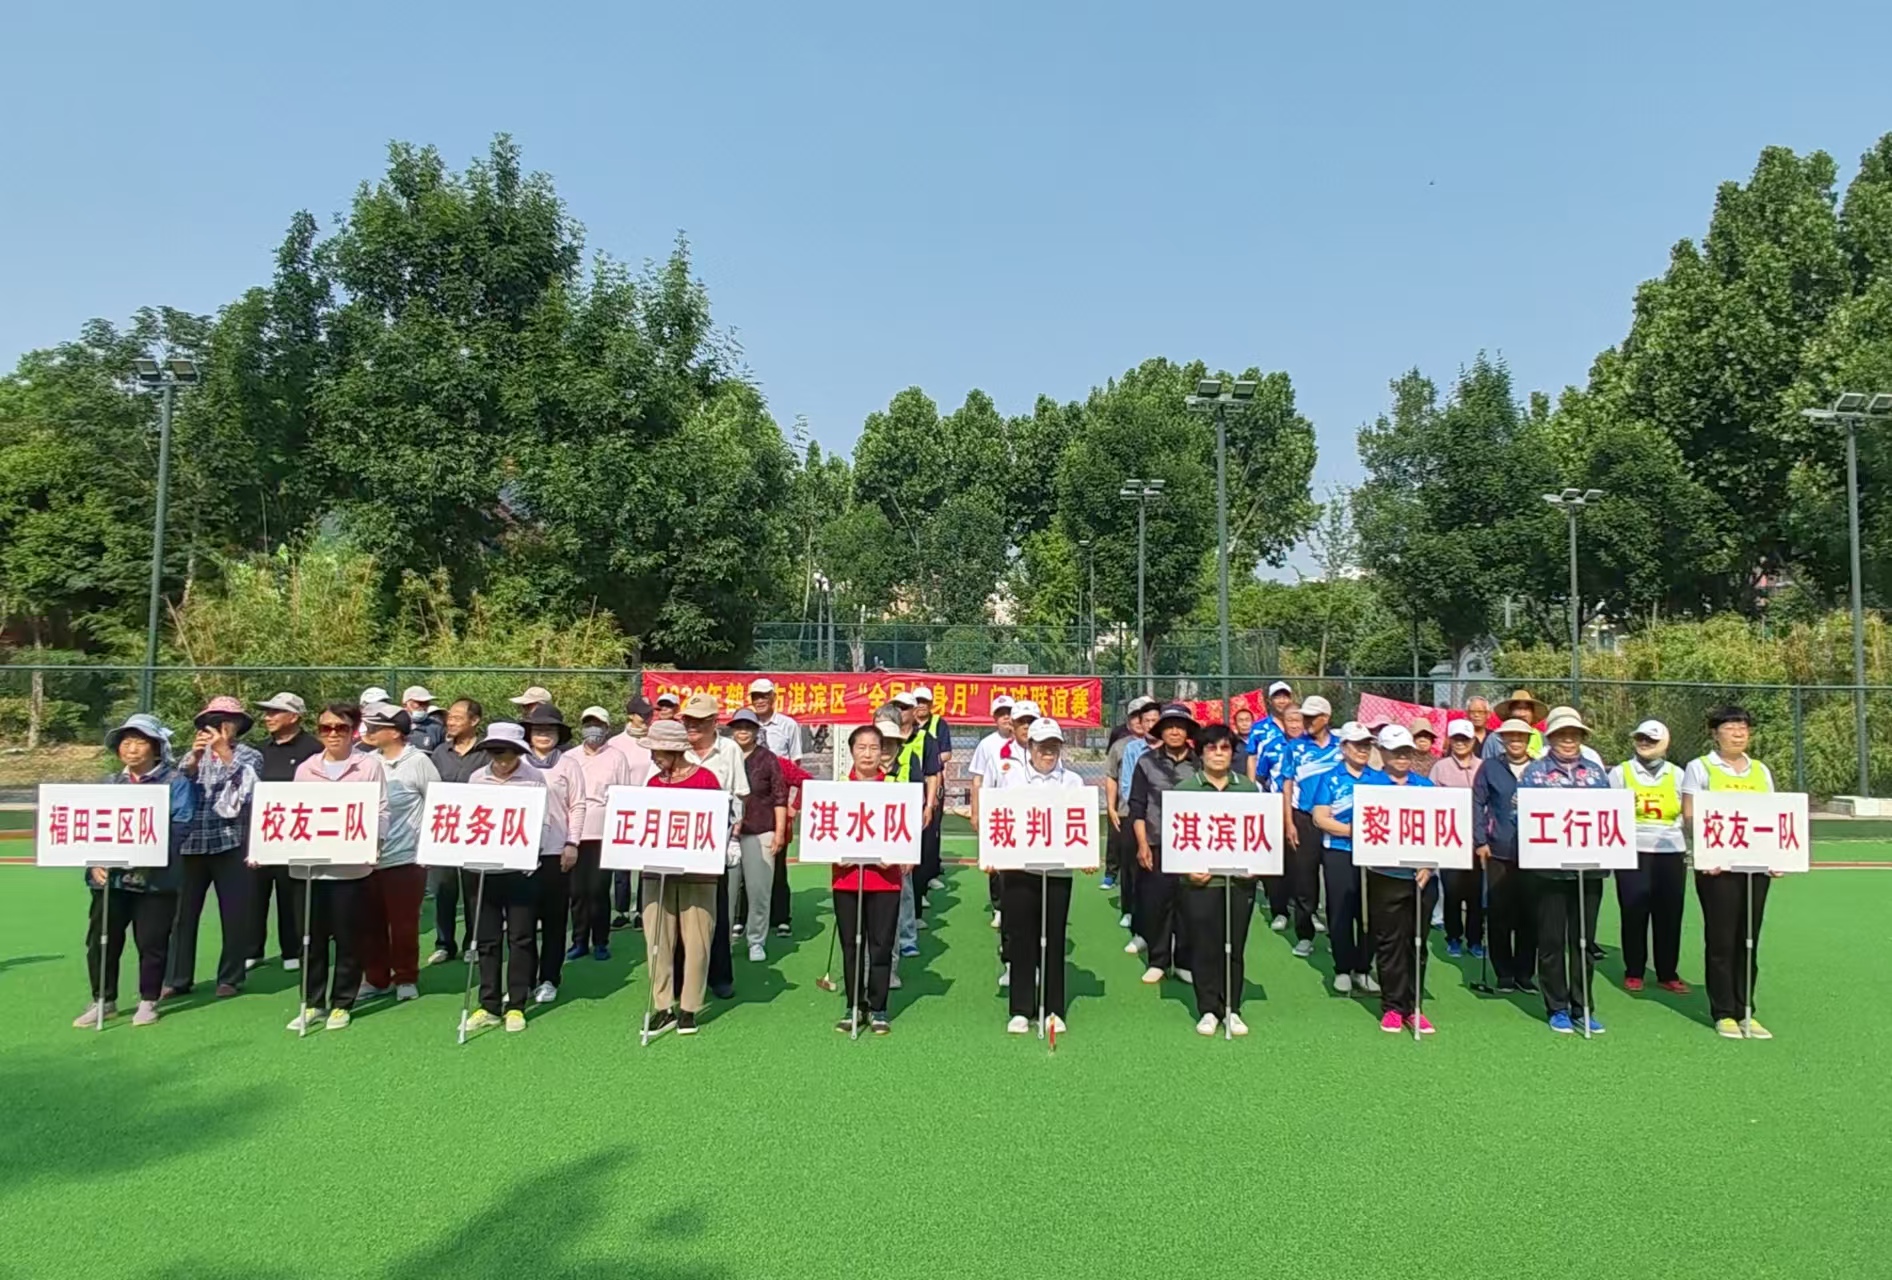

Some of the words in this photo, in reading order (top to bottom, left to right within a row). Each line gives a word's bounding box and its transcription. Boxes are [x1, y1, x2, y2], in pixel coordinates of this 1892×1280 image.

[49, 806, 155, 843] 福田三区队
[262, 803, 366, 841] 校友二队
[432, 804, 529, 845] 税务队
[612, 809, 715, 848] 正月园队
[810, 801, 912, 842] 淇水队
[989, 807, 1089, 847] 裁判员
[1362, 805, 1462, 847] 黎阳队
[1529, 810, 1626, 847] 工行队
[1643, 799, 1662, 820] 5
[1701, 809, 1799, 849] 校友一队
[1172, 813, 1269, 851] 淇滨队
